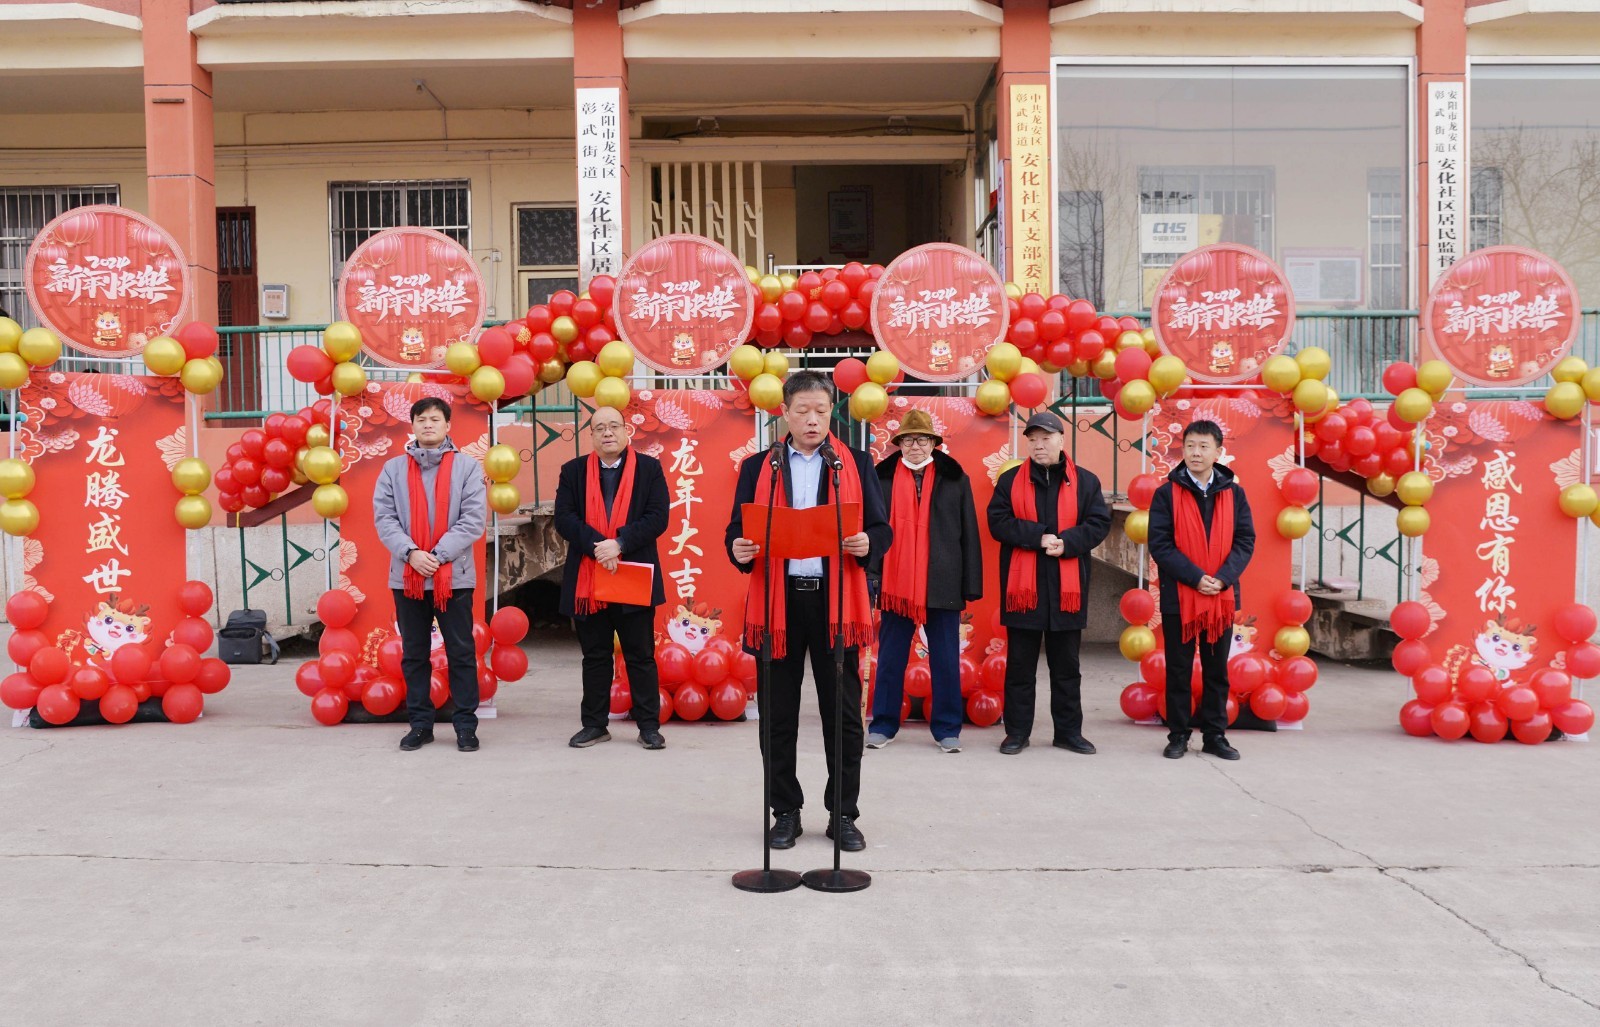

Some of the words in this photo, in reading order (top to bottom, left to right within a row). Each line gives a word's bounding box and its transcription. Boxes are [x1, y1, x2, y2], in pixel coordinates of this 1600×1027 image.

[582, 102, 598, 179] 彰武街道
[601, 101, 617, 179] 安阳市龙安区
[1016, 93, 1028, 147] 彰武街道
[1030, 93, 1042, 146] 中共龙安区
[1434, 90, 1445, 153] 彰武街道
[1447, 90, 1458, 153] 安阳市龙安区
[589, 190, 613, 278] 安化社区居
[1152, 222, 1187, 233] CHS
[1436, 158, 1457, 277] 安化社区居民监督
[44, 257, 176, 306] 新年快樂
[84, 256, 131, 271] 2024
[390, 273, 431, 288] 2024
[661, 279, 701, 294] 2024
[355, 279, 472, 325] 新年快樂
[628, 285, 742, 331] 新年快樂
[886, 292, 997, 338] 新年快樂
[919, 287, 957, 301] 2024
[1167, 293, 1283, 340] 新年快樂
[1200, 288, 1241, 302] 2024
[1477, 290, 1522, 306] 2024
[1441, 294, 1567, 344] 新年快樂
[82, 425, 132, 594] 龙腾盛世
[668, 437, 704, 599] 龙年大吉
[1475, 449, 1522, 614] 感恩有你
